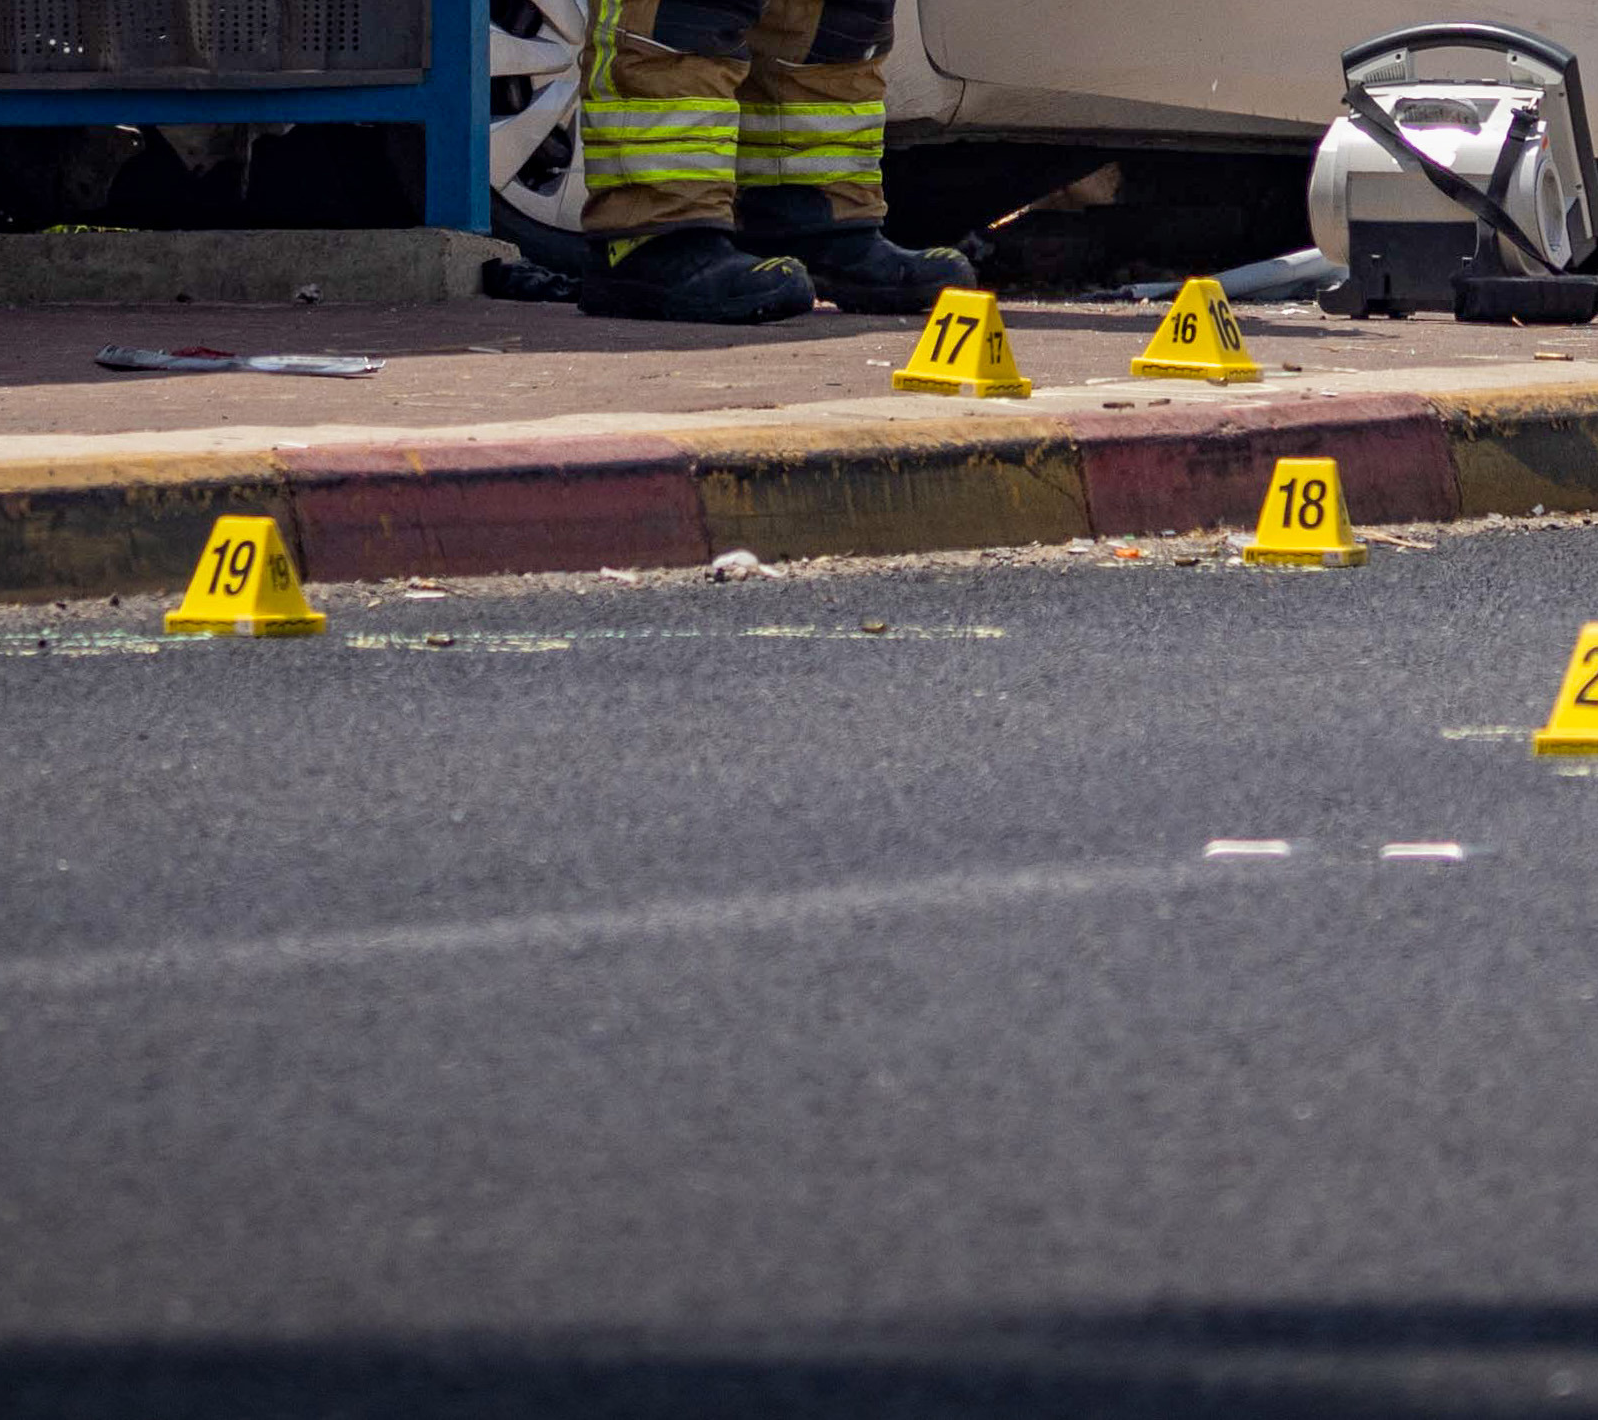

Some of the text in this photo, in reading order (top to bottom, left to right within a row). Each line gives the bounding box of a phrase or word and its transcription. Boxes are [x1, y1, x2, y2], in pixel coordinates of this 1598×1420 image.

[930, 312, 979, 365] 17
[986, 330, 1002, 365] 17
[1170, 311, 1198, 345] 16
[1209, 298, 1241, 352] 16
[1278, 477, 1328, 530] 18
[207, 538, 257, 598] 19
